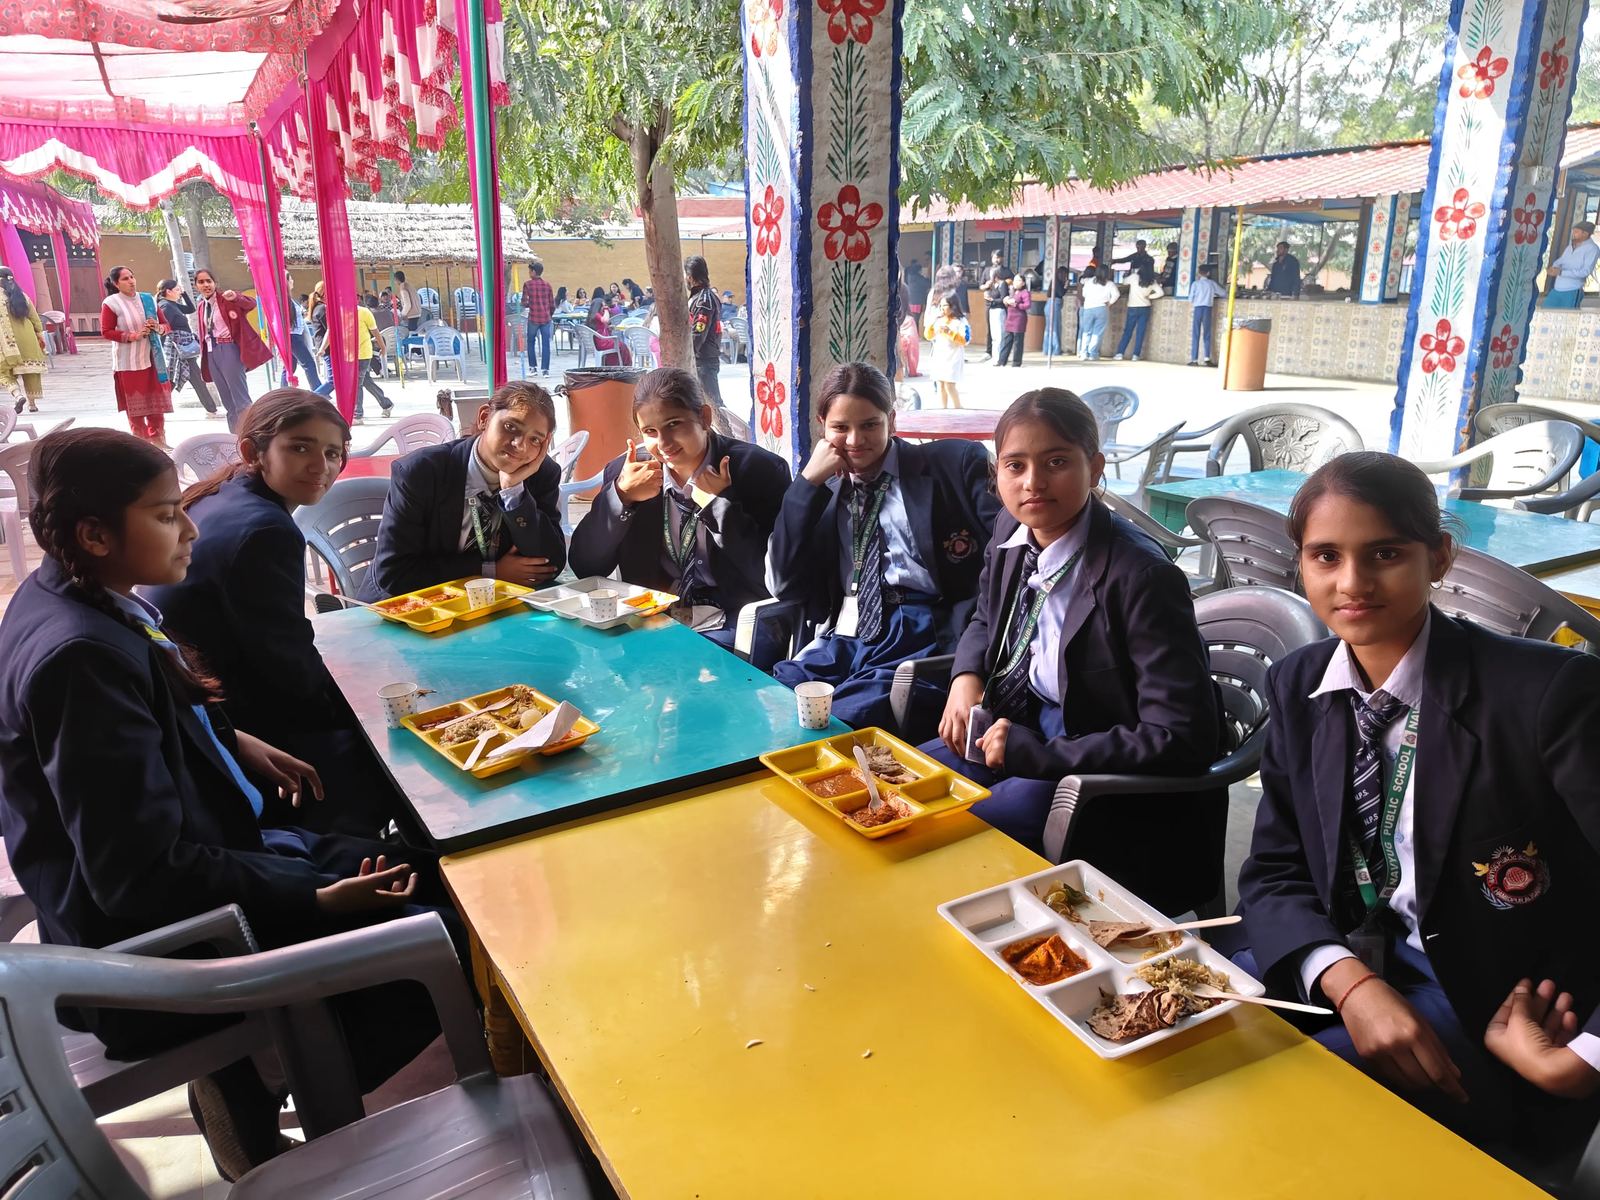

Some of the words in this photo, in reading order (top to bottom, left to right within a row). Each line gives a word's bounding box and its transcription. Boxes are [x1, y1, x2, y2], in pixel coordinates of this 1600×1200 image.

[1006, 645, 1023, 671] NAVYUG
[1023, 620, 1035, 643] PUBLIC
[1031, 593, 1046, 620] SCHOOL
[1392, 749, 1412, 793] SCHOOL
[1383, 796, 1399, 836] PUBLIC
[1384, 841, 1400, 886] NAVYUG
